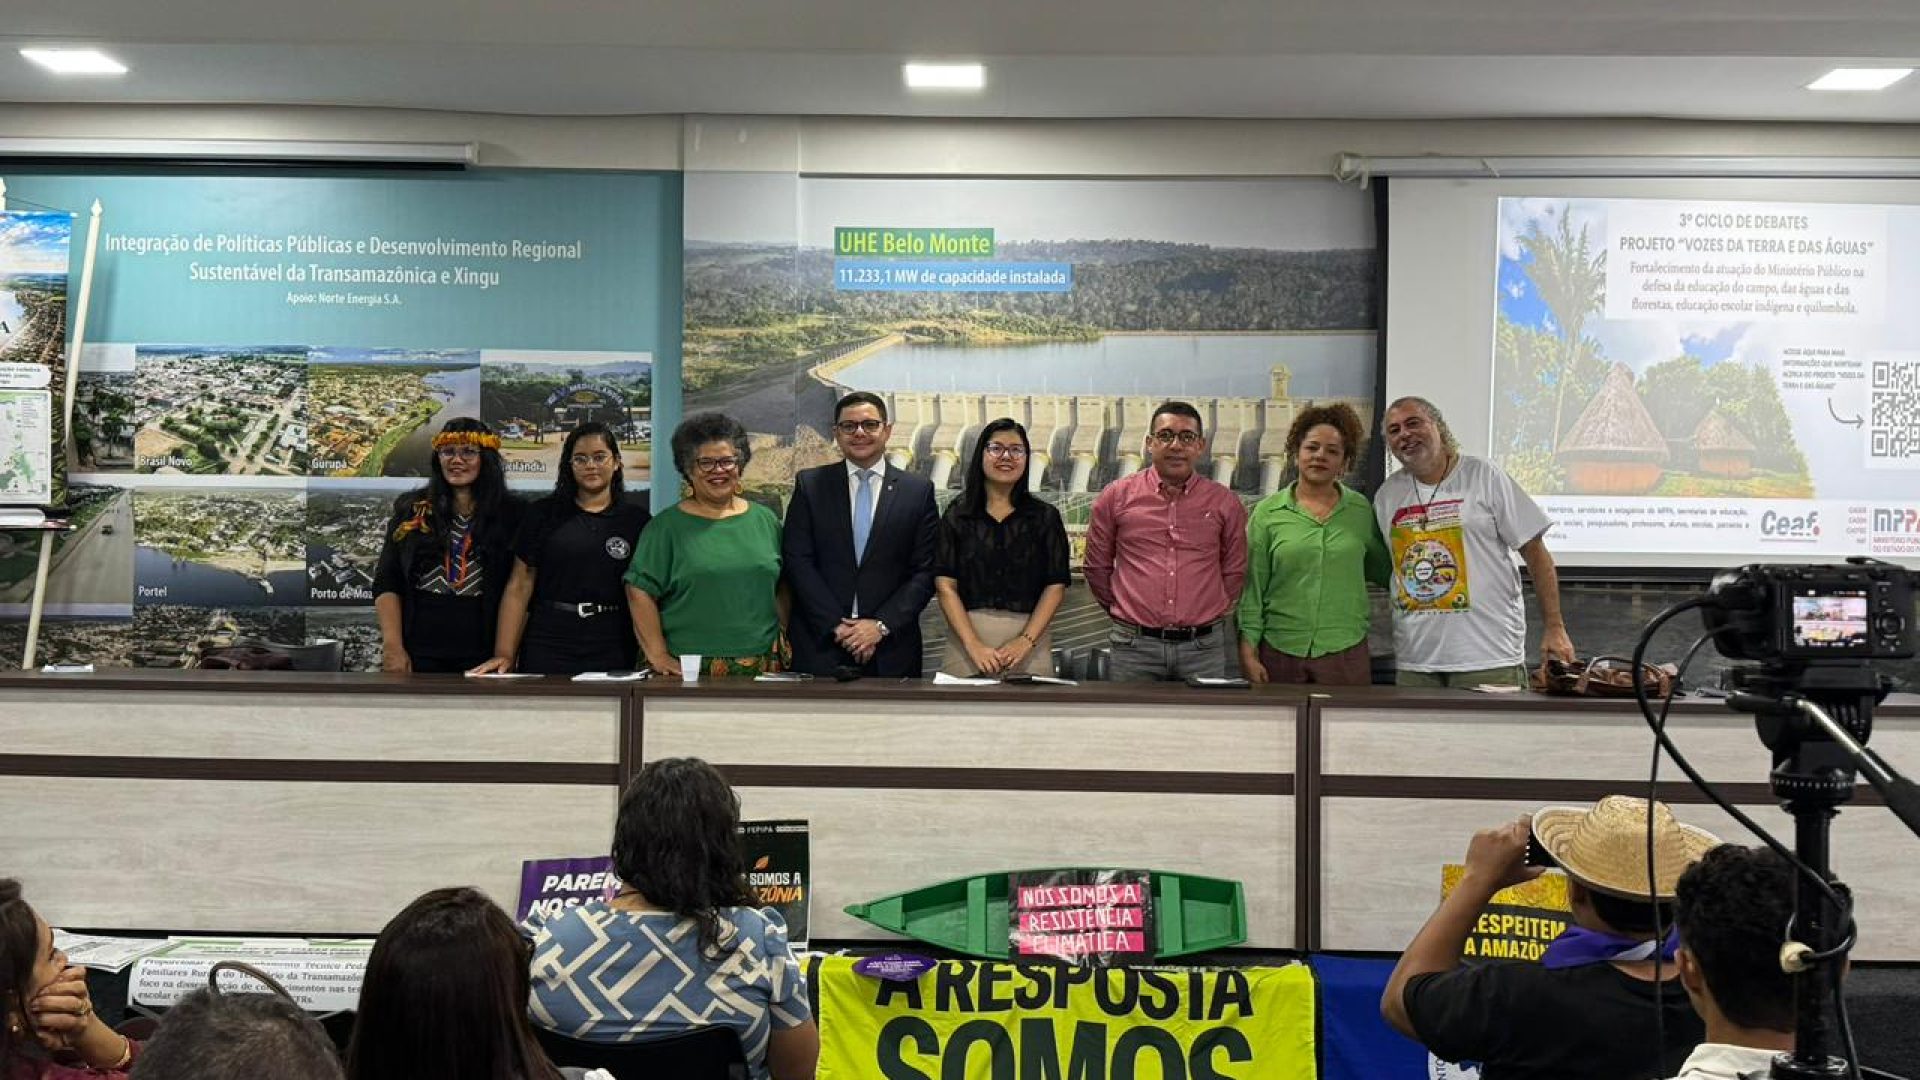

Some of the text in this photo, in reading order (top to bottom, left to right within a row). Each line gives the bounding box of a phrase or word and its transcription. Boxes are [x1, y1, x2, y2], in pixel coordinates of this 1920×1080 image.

[1695, 213, 1733, 228] CICLO
[1736, 214, 1752, 228] DE
[1754, 215, 1809, 230] DEBATES
[105, 233, 582, 262] Integração de Políticas Públicas e Desenvolvimento Regional
[839, 231, 991, 254] UHE Belo Monte
[1619, 236, 1675, 252] PROJETO
[1727, 239, 1744, 253] DA
[1747, 239, 1786, 253] TERRA
[1788, 239, 1796, 253] E
[1798, 240, 1823, 254] DAS
[189, 262, 500, 289] Sustentável da Transamazônica e Xingu
[839, 269, 1067, 287] 11.233,1 MW de capacidade instalada
[1630, 260, 1865, 278] Fortalecimento da atuação do Ministério Público na
[1641, 278, 1672, 292] defesa
[1673, 278, 1686, 292] da
[1687, 279, 1730, 296] educação
[1732, 280, 1744, 294] do
[1781, 281, 1798, 294] das
[1799, 281, 1825, 299] águas
[1826, 285, 1833, 295] e
[1834, 281, 1850, 295] das
[286, 291, 317, 306] Apoio:
[318, 292, 345, 304] Norte
[347, 293, 382, 307] Energia
[1675, 298, 1720, 314] educação
[1720, 299, 1753, 312] escolar
[1755, 299, 1795, 316] indígena
[1796, 304, 1802, 313] e
[140, 456, 193, 468] Brasil Novo
[311, 457, 347, 470] Gurupá
[138, 585, 167, 597] Portel
[311, 587, 337, 599] Porto
[339, 587, 352, 599] de
[541, 871, 624, 893] PAREM
[749, 872, 790, 886] SOMOS
[793, 871, 801, 886] A
[757, 886, 803, 903] ZÔNIA
[1022, 884, 1137, 907] NÓS SOMOS A
[1028, 905, 1135, 932] RESISTÊNCIA
[1473, 913, 1567, 940] ESPEITEM
[1463, 937, 1476, 956] A
[935, 960, 1254, 1021] RESPOSTA
[876, 1015, 1254, 1080] SOMOS
